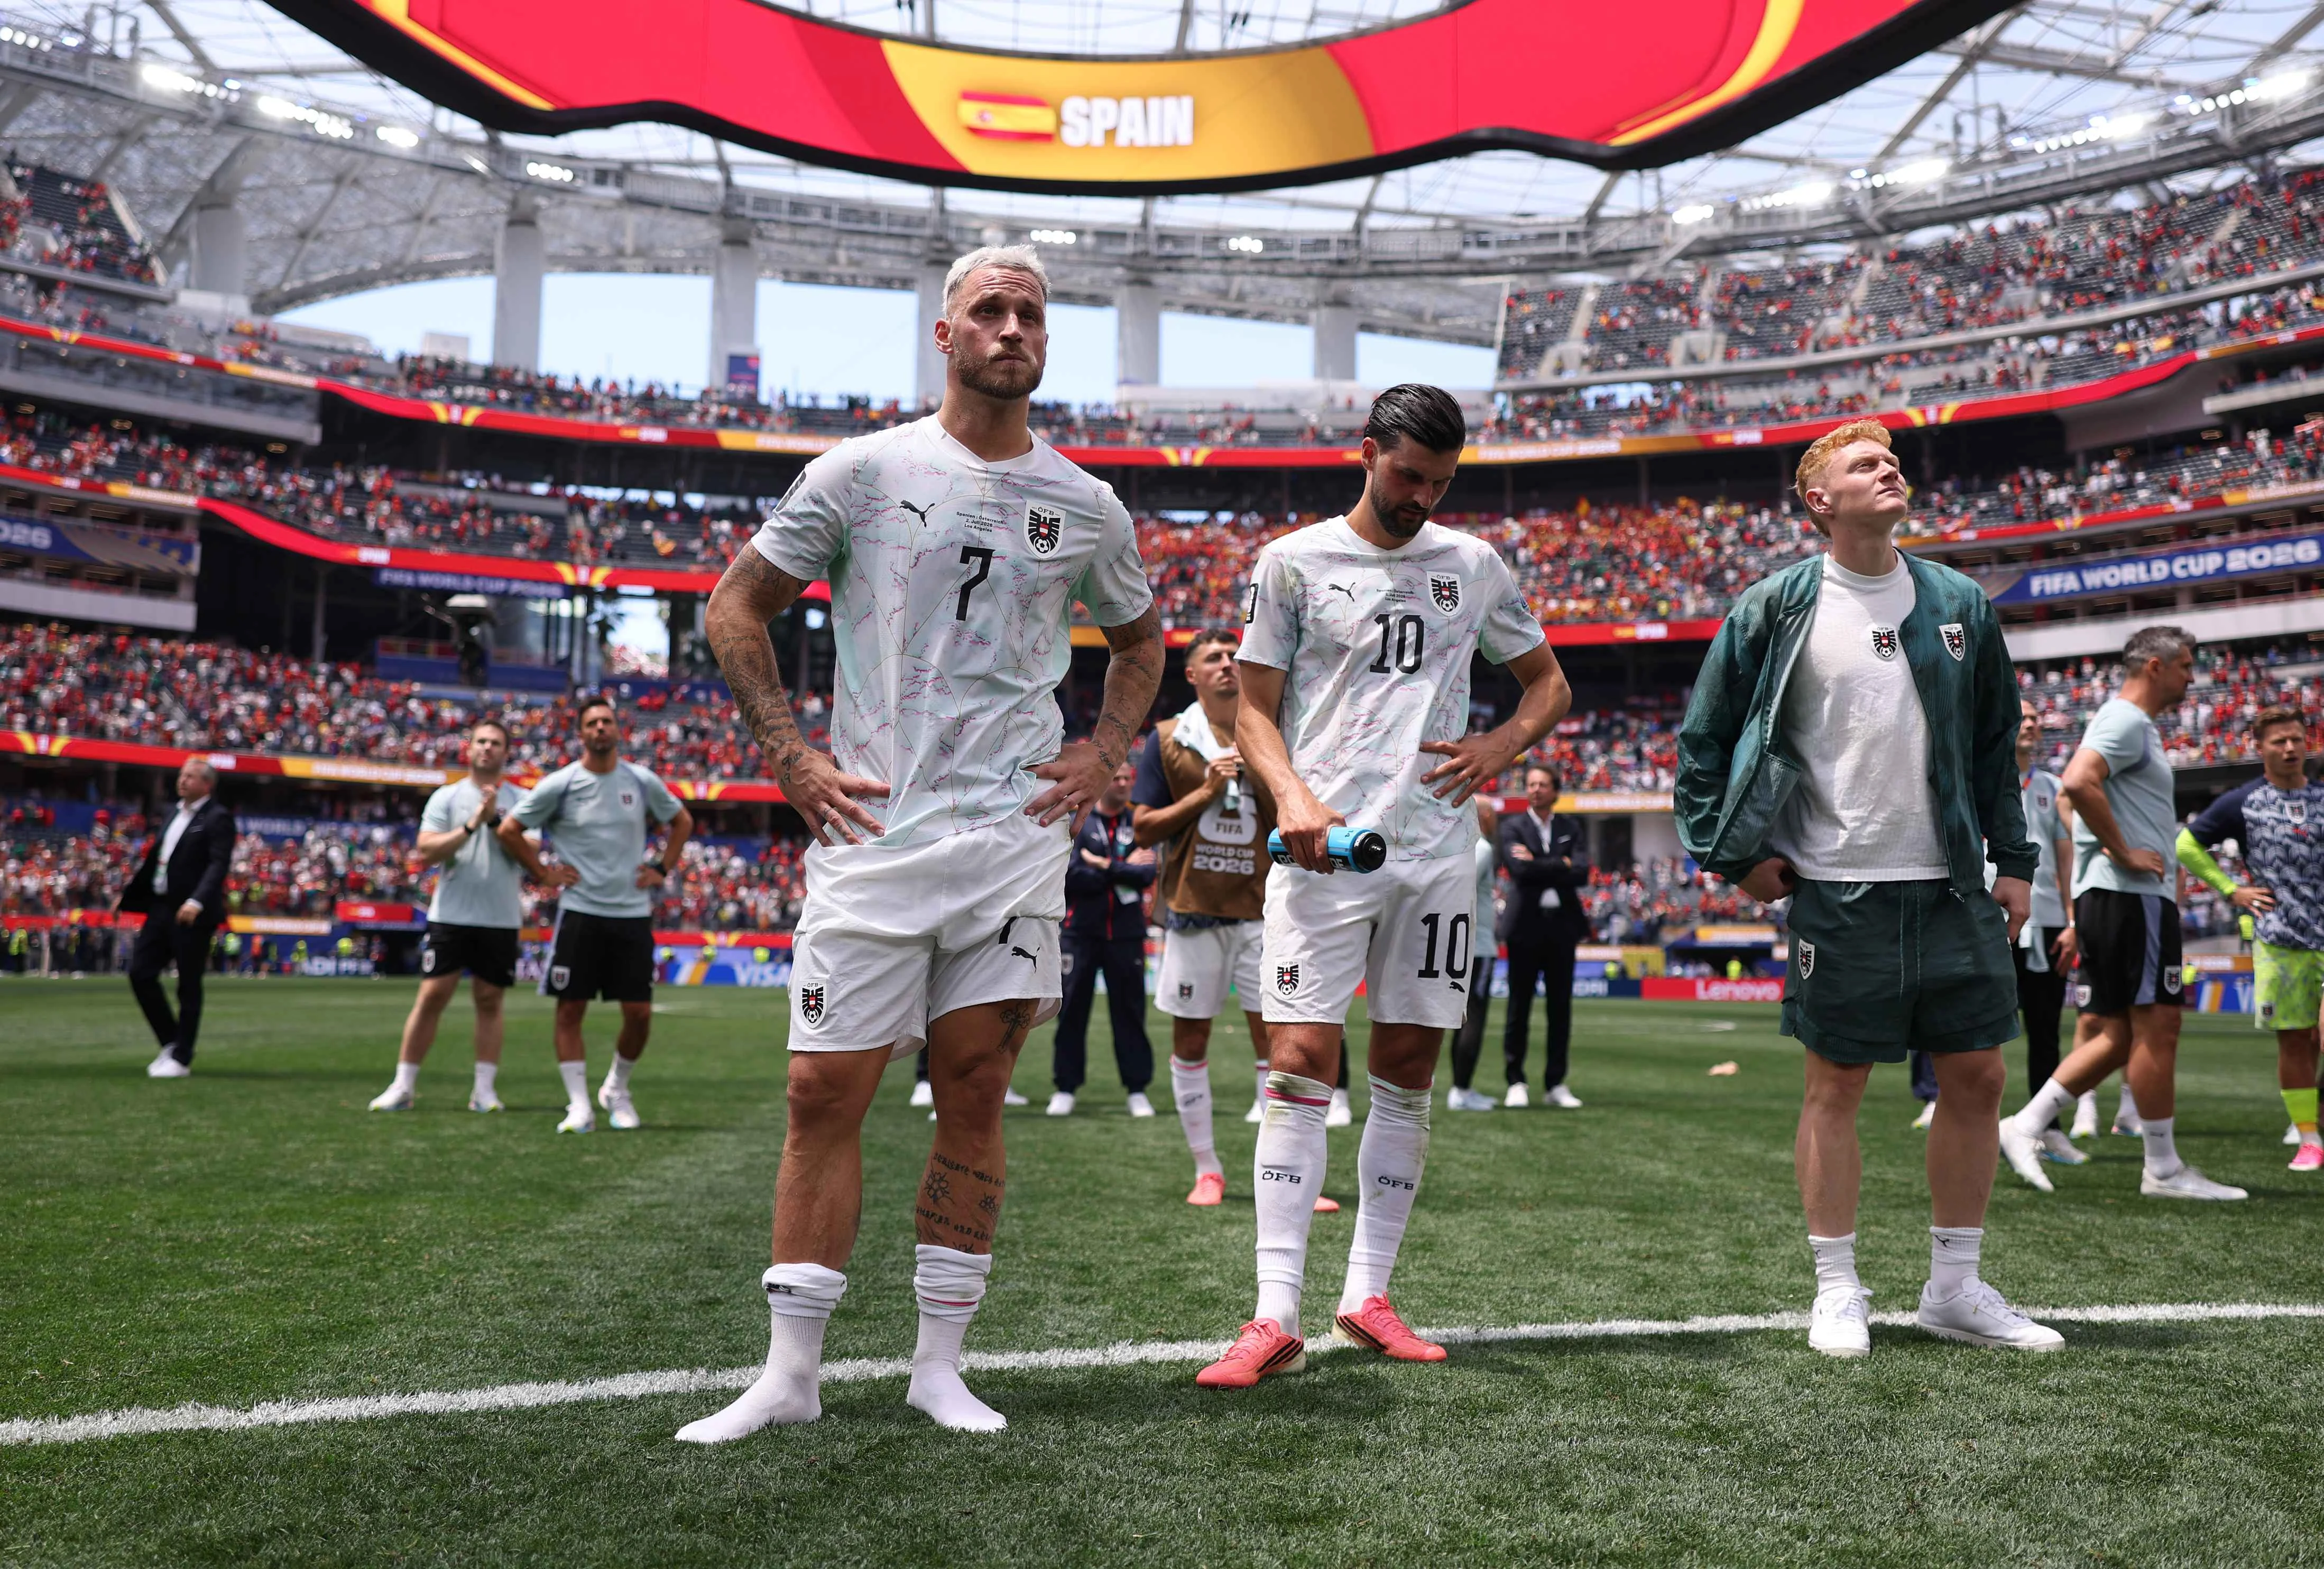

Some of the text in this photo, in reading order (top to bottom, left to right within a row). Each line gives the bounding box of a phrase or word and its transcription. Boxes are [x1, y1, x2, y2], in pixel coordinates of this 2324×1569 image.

[1060, 95, 1194, 147] SPAIN
[979, 515, 1004, 524] Österreich
[1038, 506, 1054, 516] ÖFB
[2030, 539, 2321, 597] FIFA WORLD CUP 2026
[956, 546, 995, 621] 7
[1370, 614, 1425, 675] 10
[1216, 823, 1243, 835] FIFA
[1196, 844, 1256, 859] WORLD CUP
[1193, 854, 1255, 875] 2026
[1418, 913, 1470, 979] 10
[1696, 981, 1781, 1001] Lenovo
[1262, 1170, 1301, 1184] ÖFB
[1378, 1175, 1414, 1190] ÖFB
